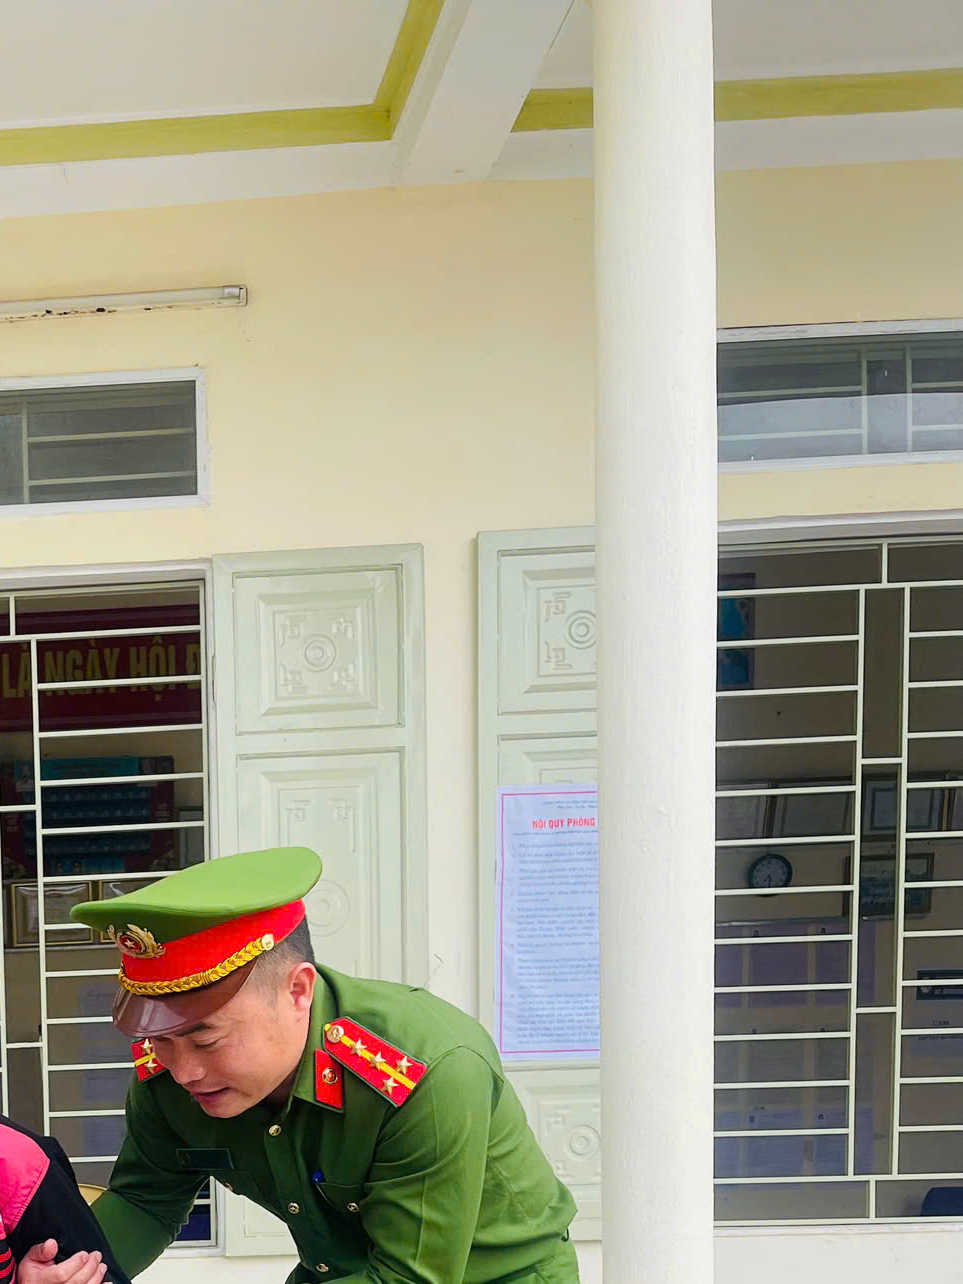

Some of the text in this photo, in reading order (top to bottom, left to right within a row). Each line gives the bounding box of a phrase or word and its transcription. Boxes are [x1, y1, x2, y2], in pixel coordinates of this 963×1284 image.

[44, 639, 120, 697] NGÀY
[129, 636, 176, 702] HỘI
[548, 818, 565, 829] QUY
[566, 815, 596, 827] PHÒNG
